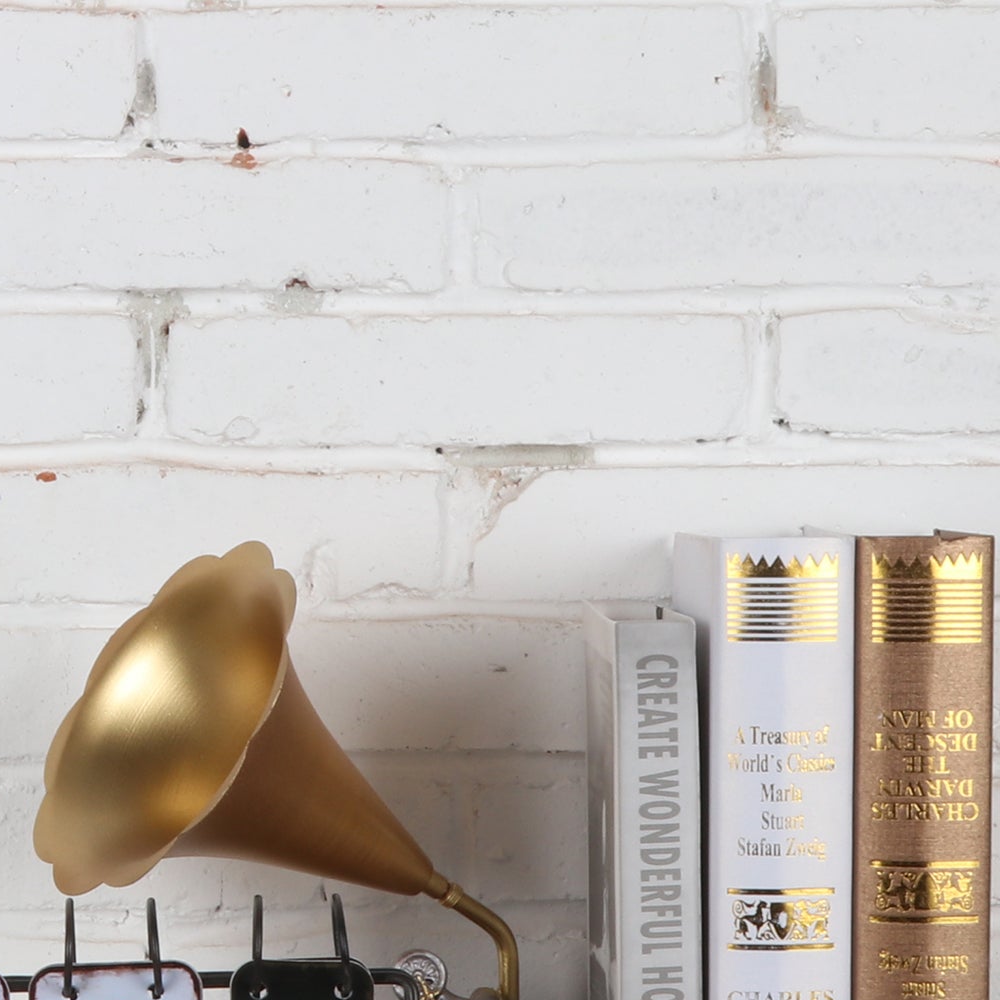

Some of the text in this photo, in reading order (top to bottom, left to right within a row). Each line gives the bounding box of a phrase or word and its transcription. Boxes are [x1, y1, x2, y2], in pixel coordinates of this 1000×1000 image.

[636, 653, 679, 760] CREATE
[880, 709, 974, 730] OF MAN
[734, 724, 831, 750] A Treasury of
[870, 732, 978, 752] DESCENT
[785, 752, 836, 774] Classics
[902, 755, 951, 775] THE
[878, 778, 974, 798] DARWIN
[760, 810, 806, 831] Stuart
[871, 802, 980, 822] CHARLES
[737, 837, 828, 861] Stafan Zweig
[637, 768, 684, 956] WONDERFUL
